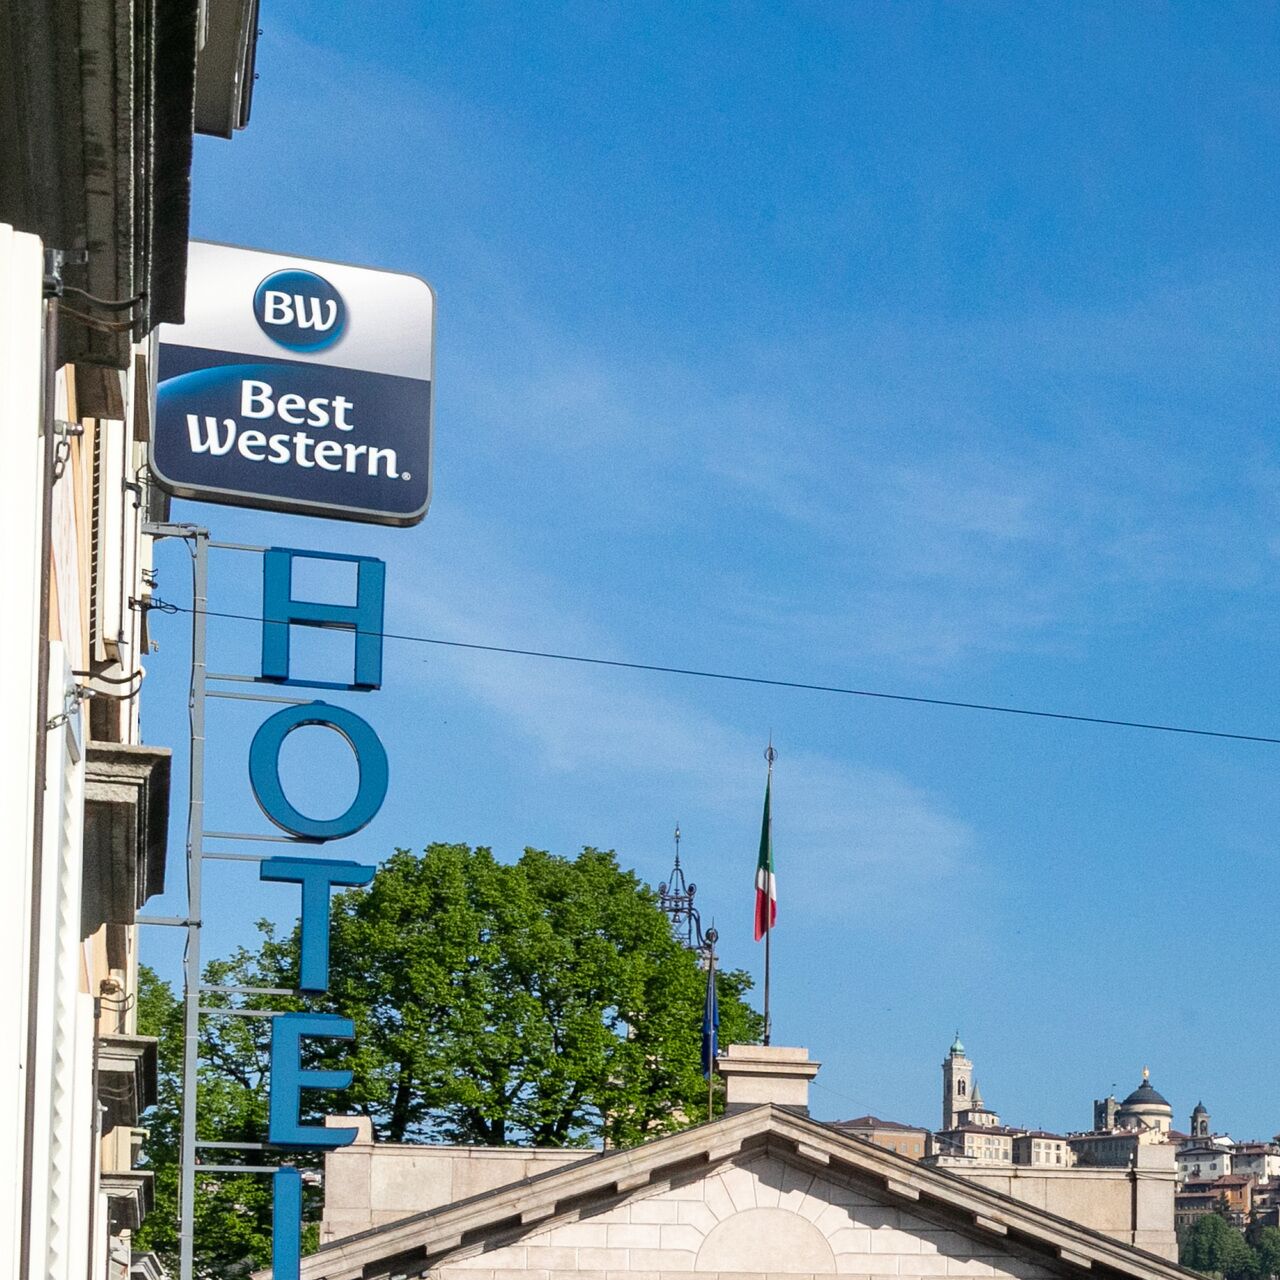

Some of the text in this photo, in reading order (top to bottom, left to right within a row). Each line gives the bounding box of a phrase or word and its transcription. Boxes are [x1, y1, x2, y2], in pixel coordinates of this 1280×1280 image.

[264, 290, 338, 331] BW
[240, 379, 354, 432] Best
[186, 414, 399, 480] Western
